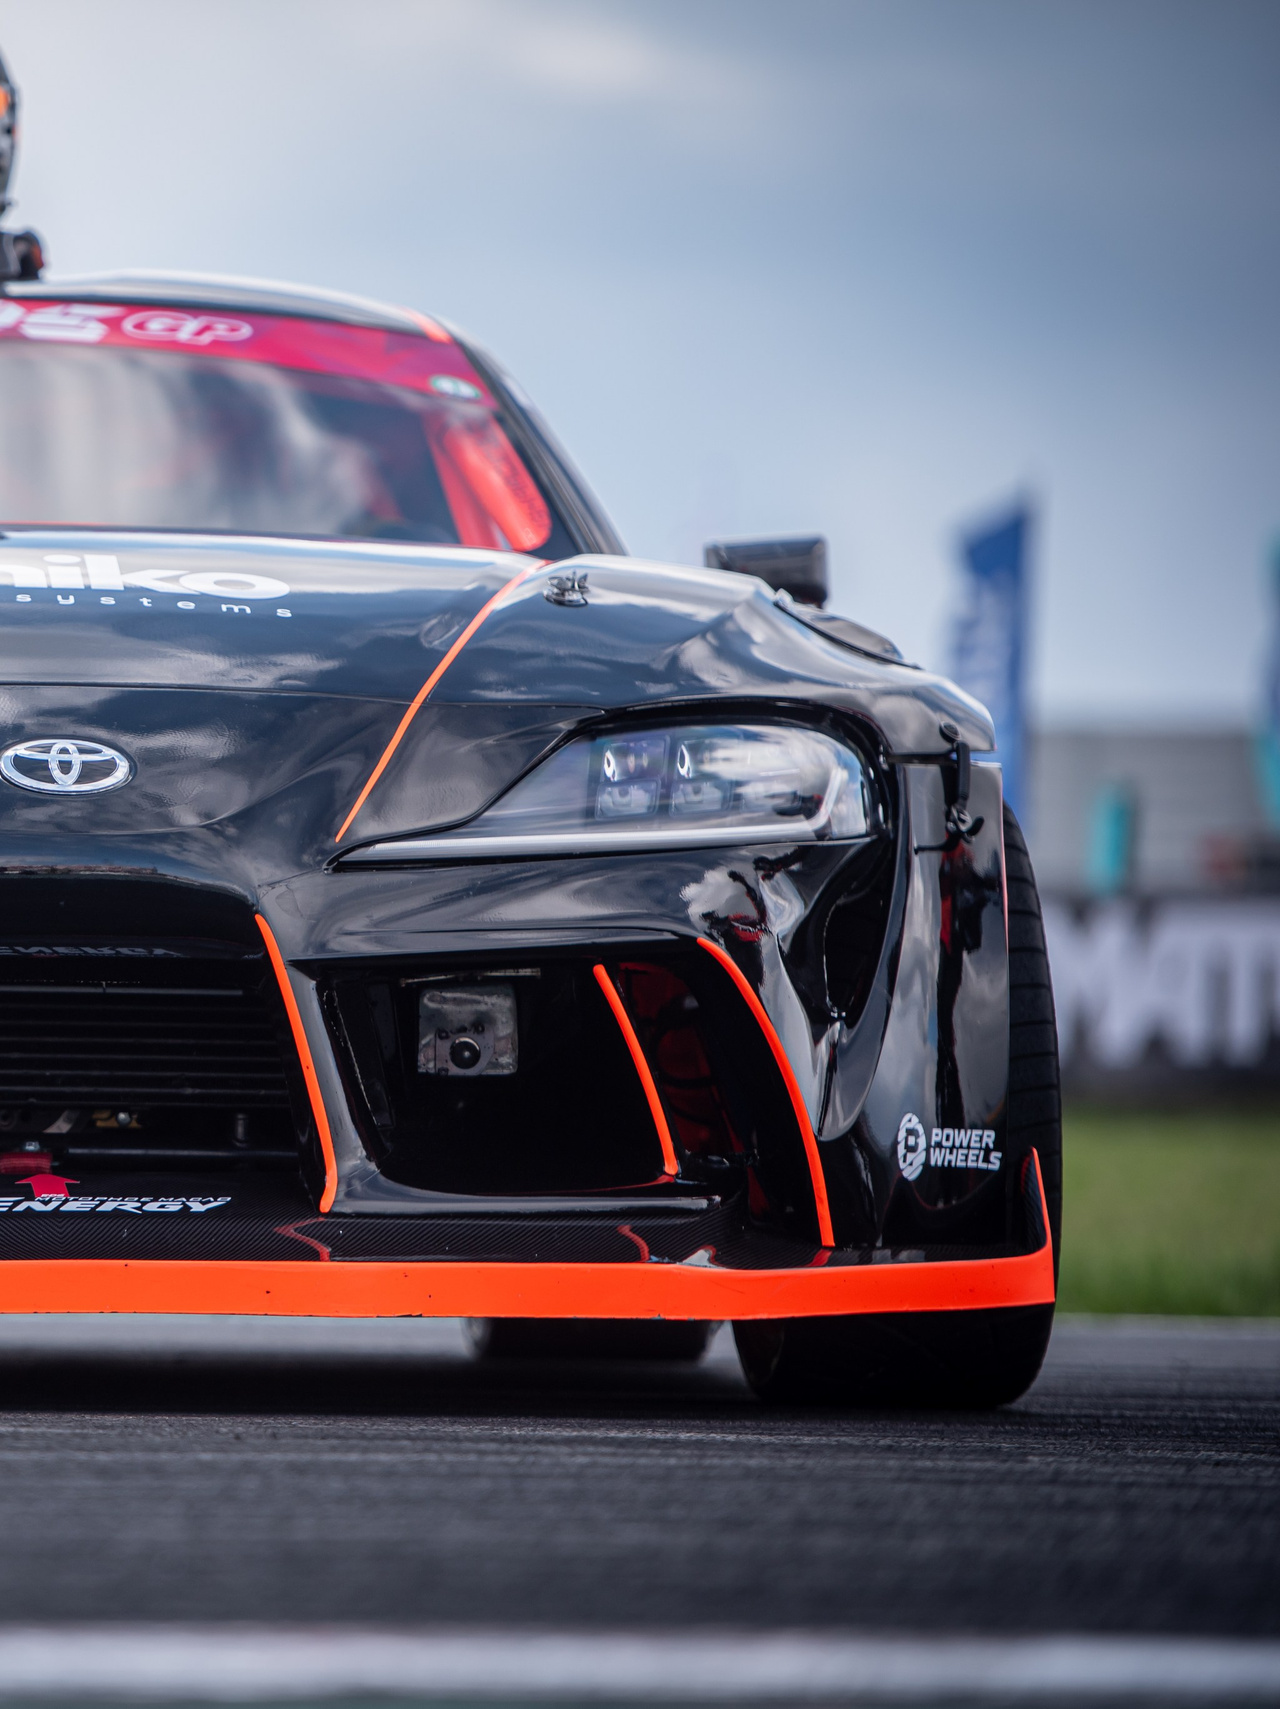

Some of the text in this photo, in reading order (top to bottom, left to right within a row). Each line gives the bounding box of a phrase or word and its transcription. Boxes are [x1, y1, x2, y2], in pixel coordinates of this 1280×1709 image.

[16, 594, 292, 618] systems
[931, 1127, 996, 1150] POWER
[930, 1146, 1003, 1172] WHEELS
